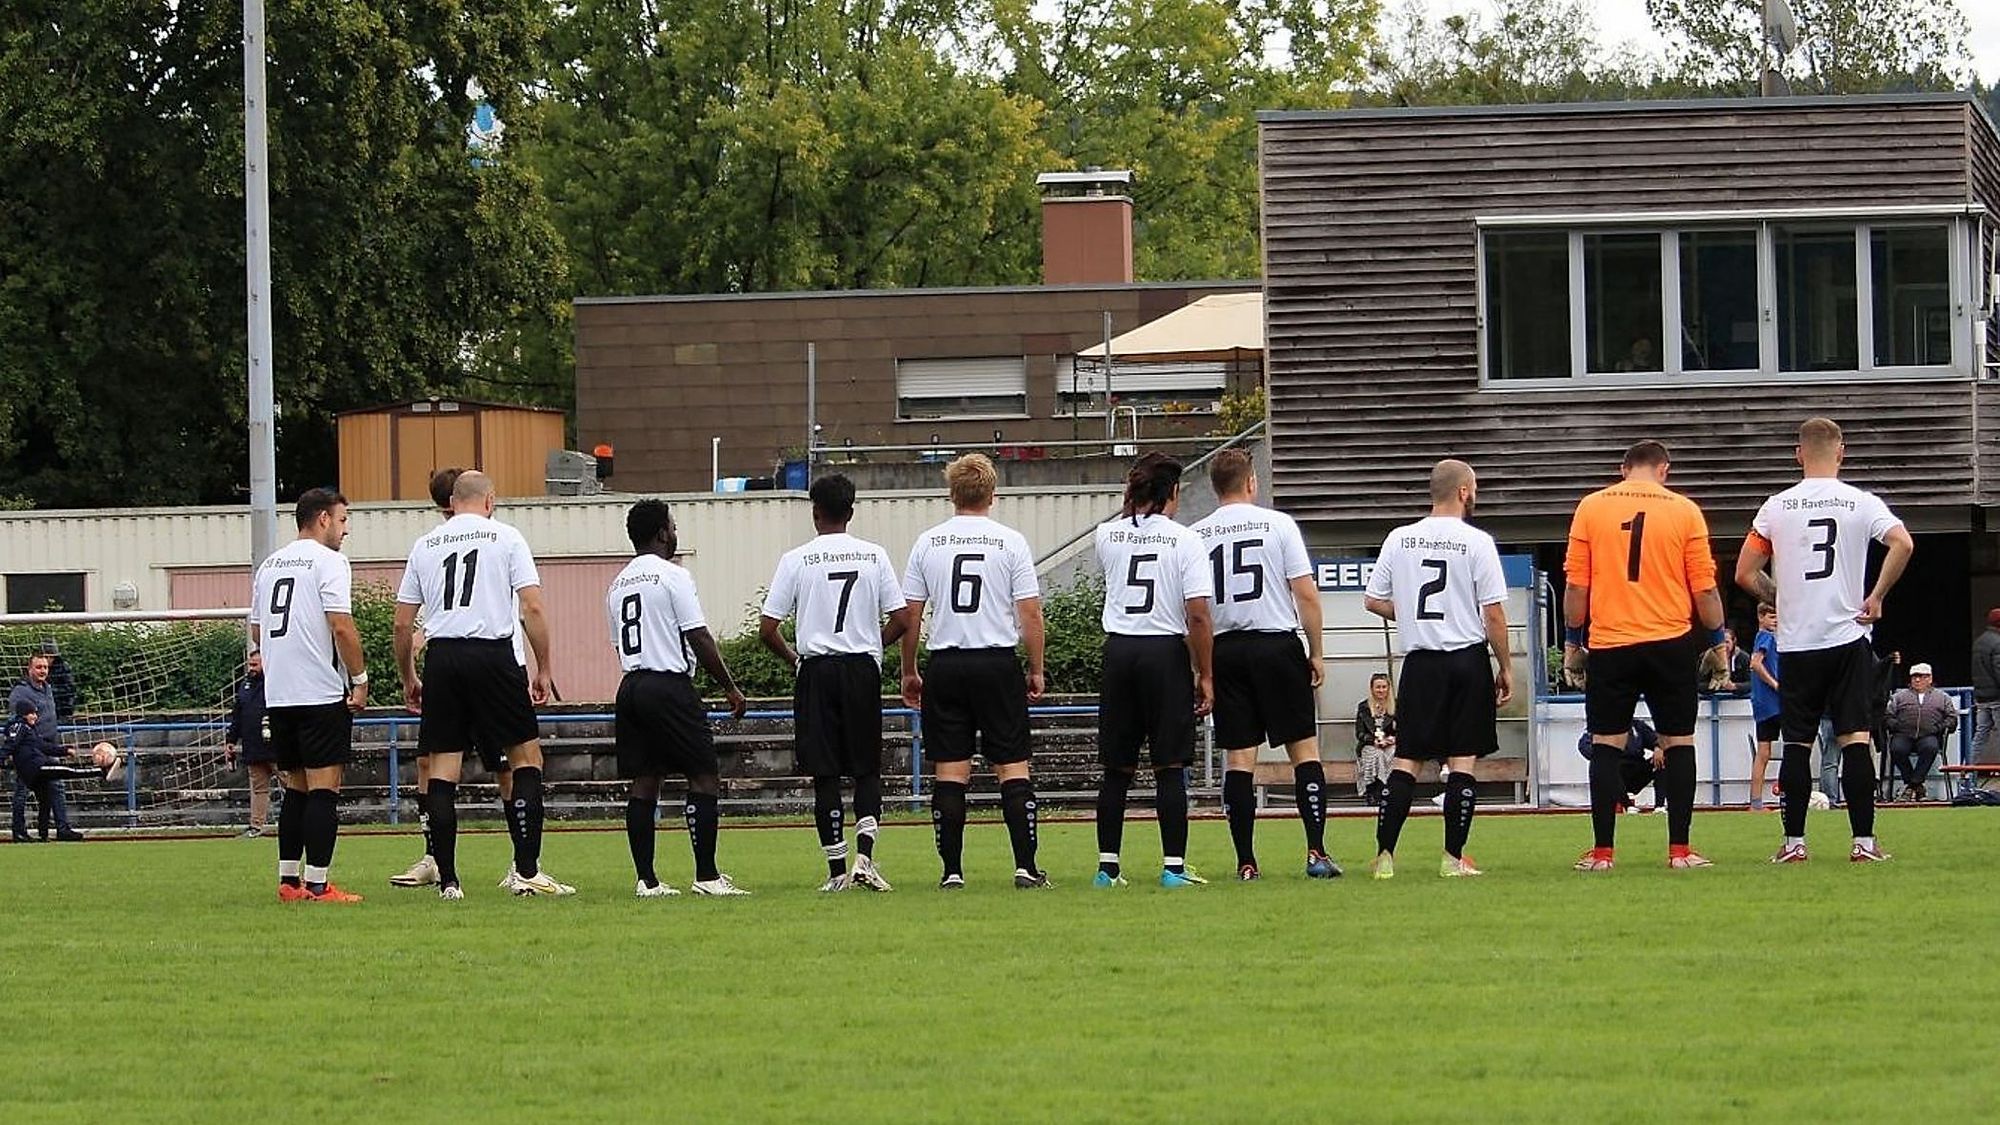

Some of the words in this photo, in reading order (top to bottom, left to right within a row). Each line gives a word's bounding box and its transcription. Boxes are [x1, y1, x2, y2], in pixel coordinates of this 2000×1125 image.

[1214, 520, 1270, 535] Ravensburg
[1782, 498, 1799, 510] TSB
[1801, 497, 1856, 511] Ravensburg
[426, 535, 442, 549] TSB
[443, 530, 497, 543] Ravensburg
[803, 553, 821, 566] TSB
[822, 551, 877, 564] Ravensburg
[930, 535, 947, 548] TSB
[949, 534, 1004, 550] Ravensburg
[1109, 531, 1125, 543] TSB
[1126, 532, 1177, 548] Ravensburg
[1401, 537, 1416, 549] TSB
[1418, 537, 1467, 555] Ravensburg
[1620, 511, 1646, 583] 1
[1804, 517, 1838, 581] 3
[442, 549, 478, 611] 11
[827, 570, 859, 633] 7
[951, 553, 985, 613] 6
[1125, 553, 1158, 614] 5
[1208, 538, 1264, 605] 15
[1416, 559, 1447, 621] 2
[270, 577, 295, 638] 9
[621, 593, 642, 656] 8
